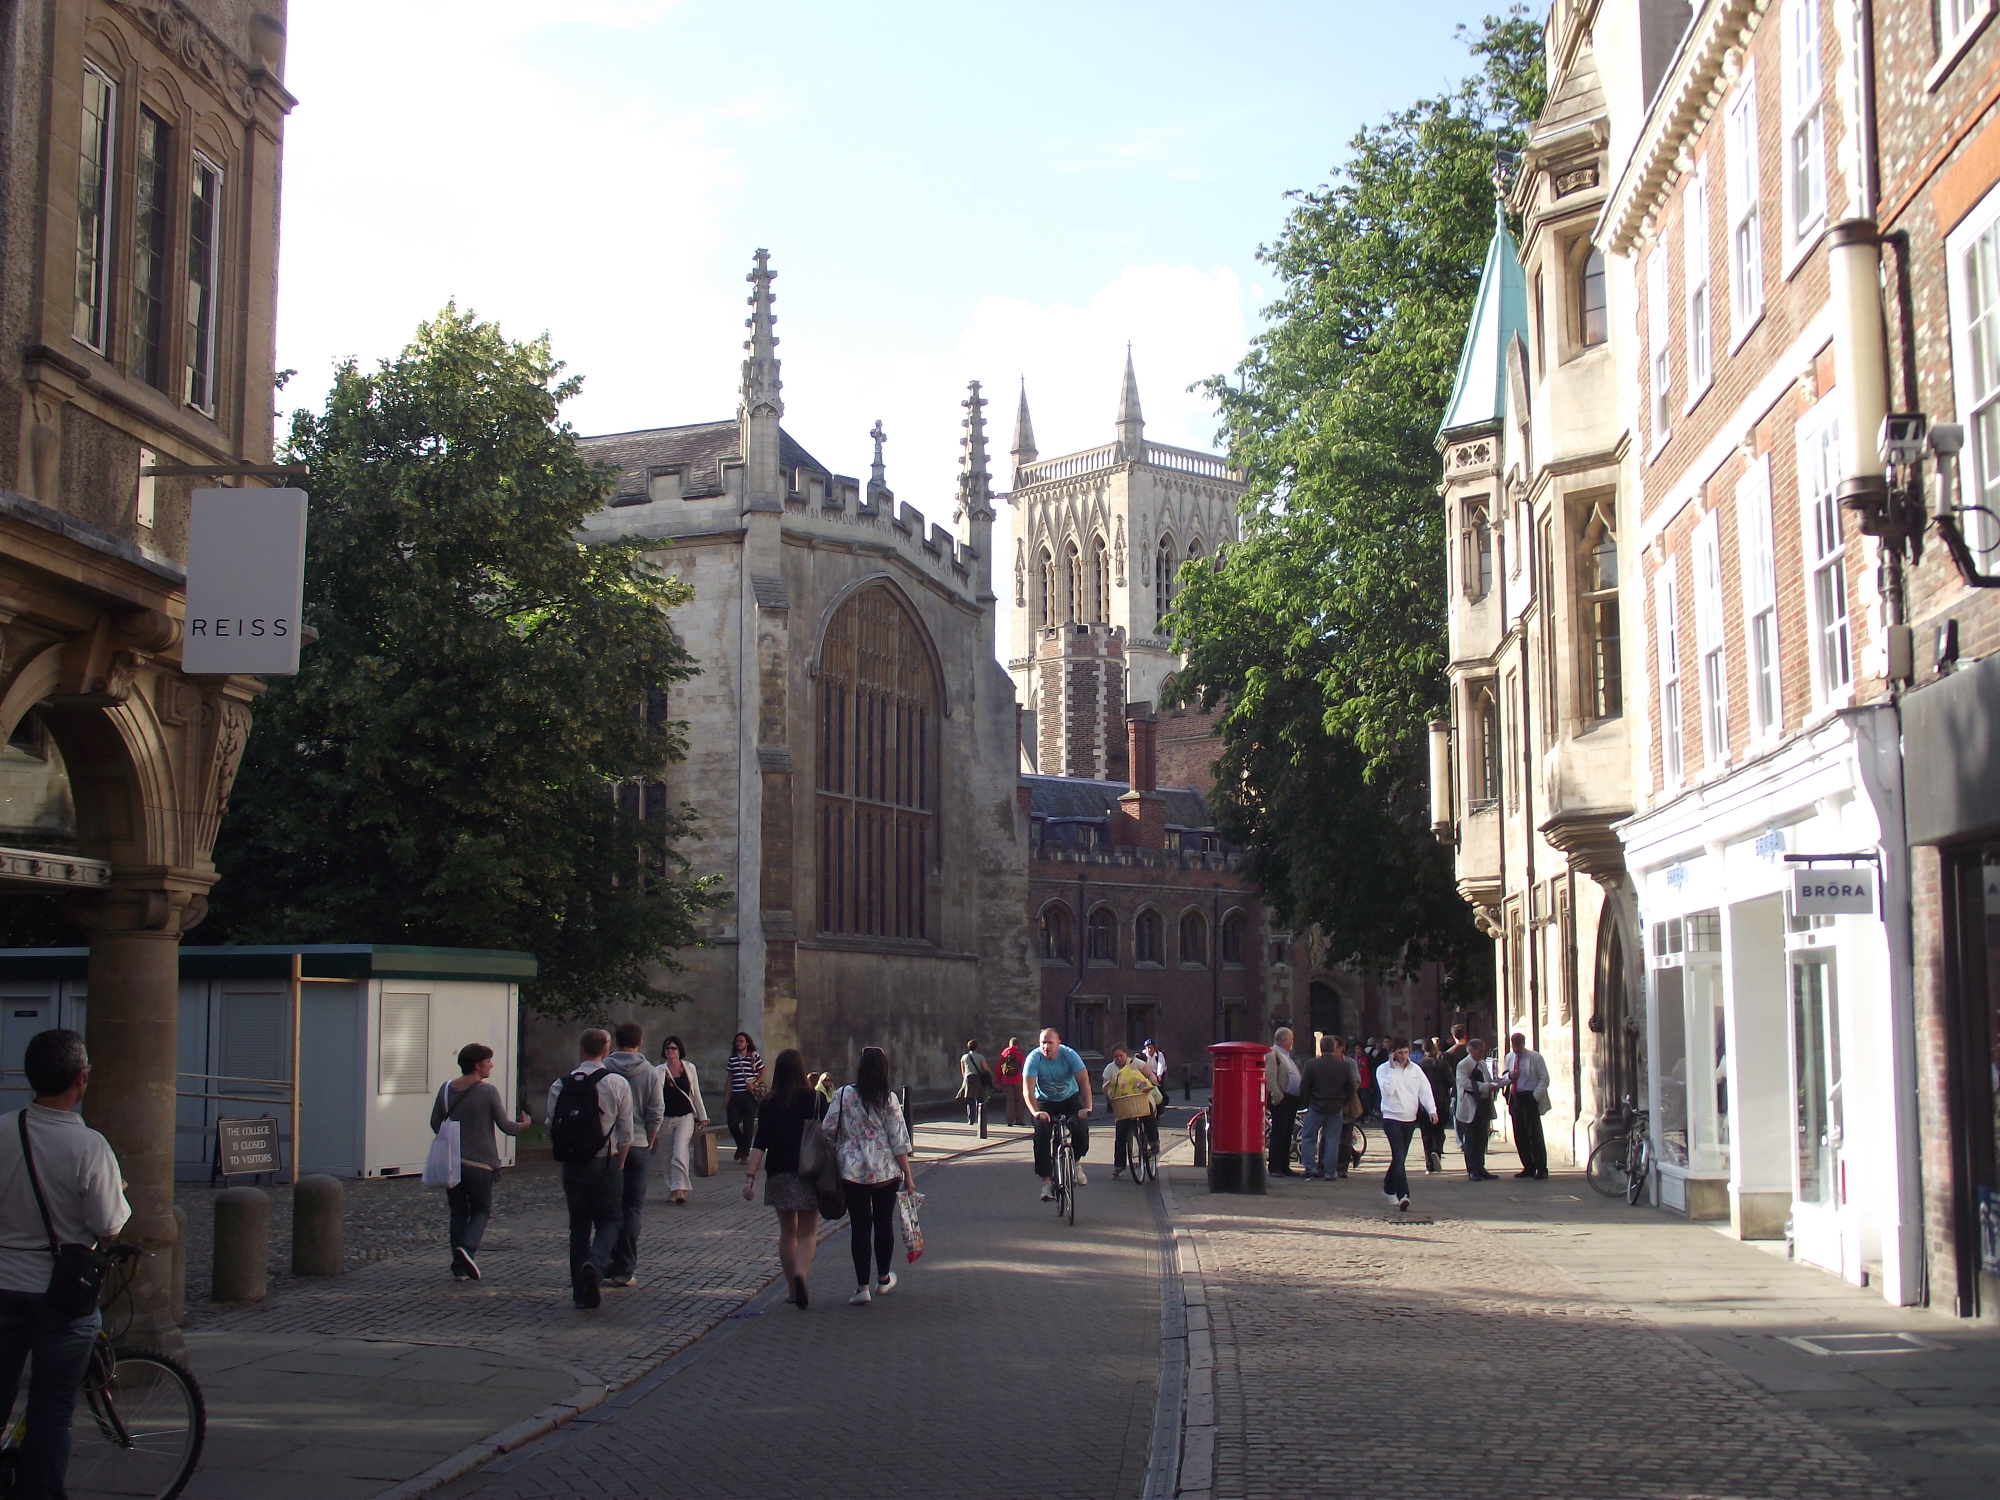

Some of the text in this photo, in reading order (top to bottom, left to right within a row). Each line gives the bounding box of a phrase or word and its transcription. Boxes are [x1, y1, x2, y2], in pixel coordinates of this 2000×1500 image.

[192, 618, 287, 637] REISS
[227, 1126, 271, 1136] THE COLLEGE
[232, 1140, 267, 1150] IS CLOSED
[229, 1154, 273, 1165] TO VISITORS
